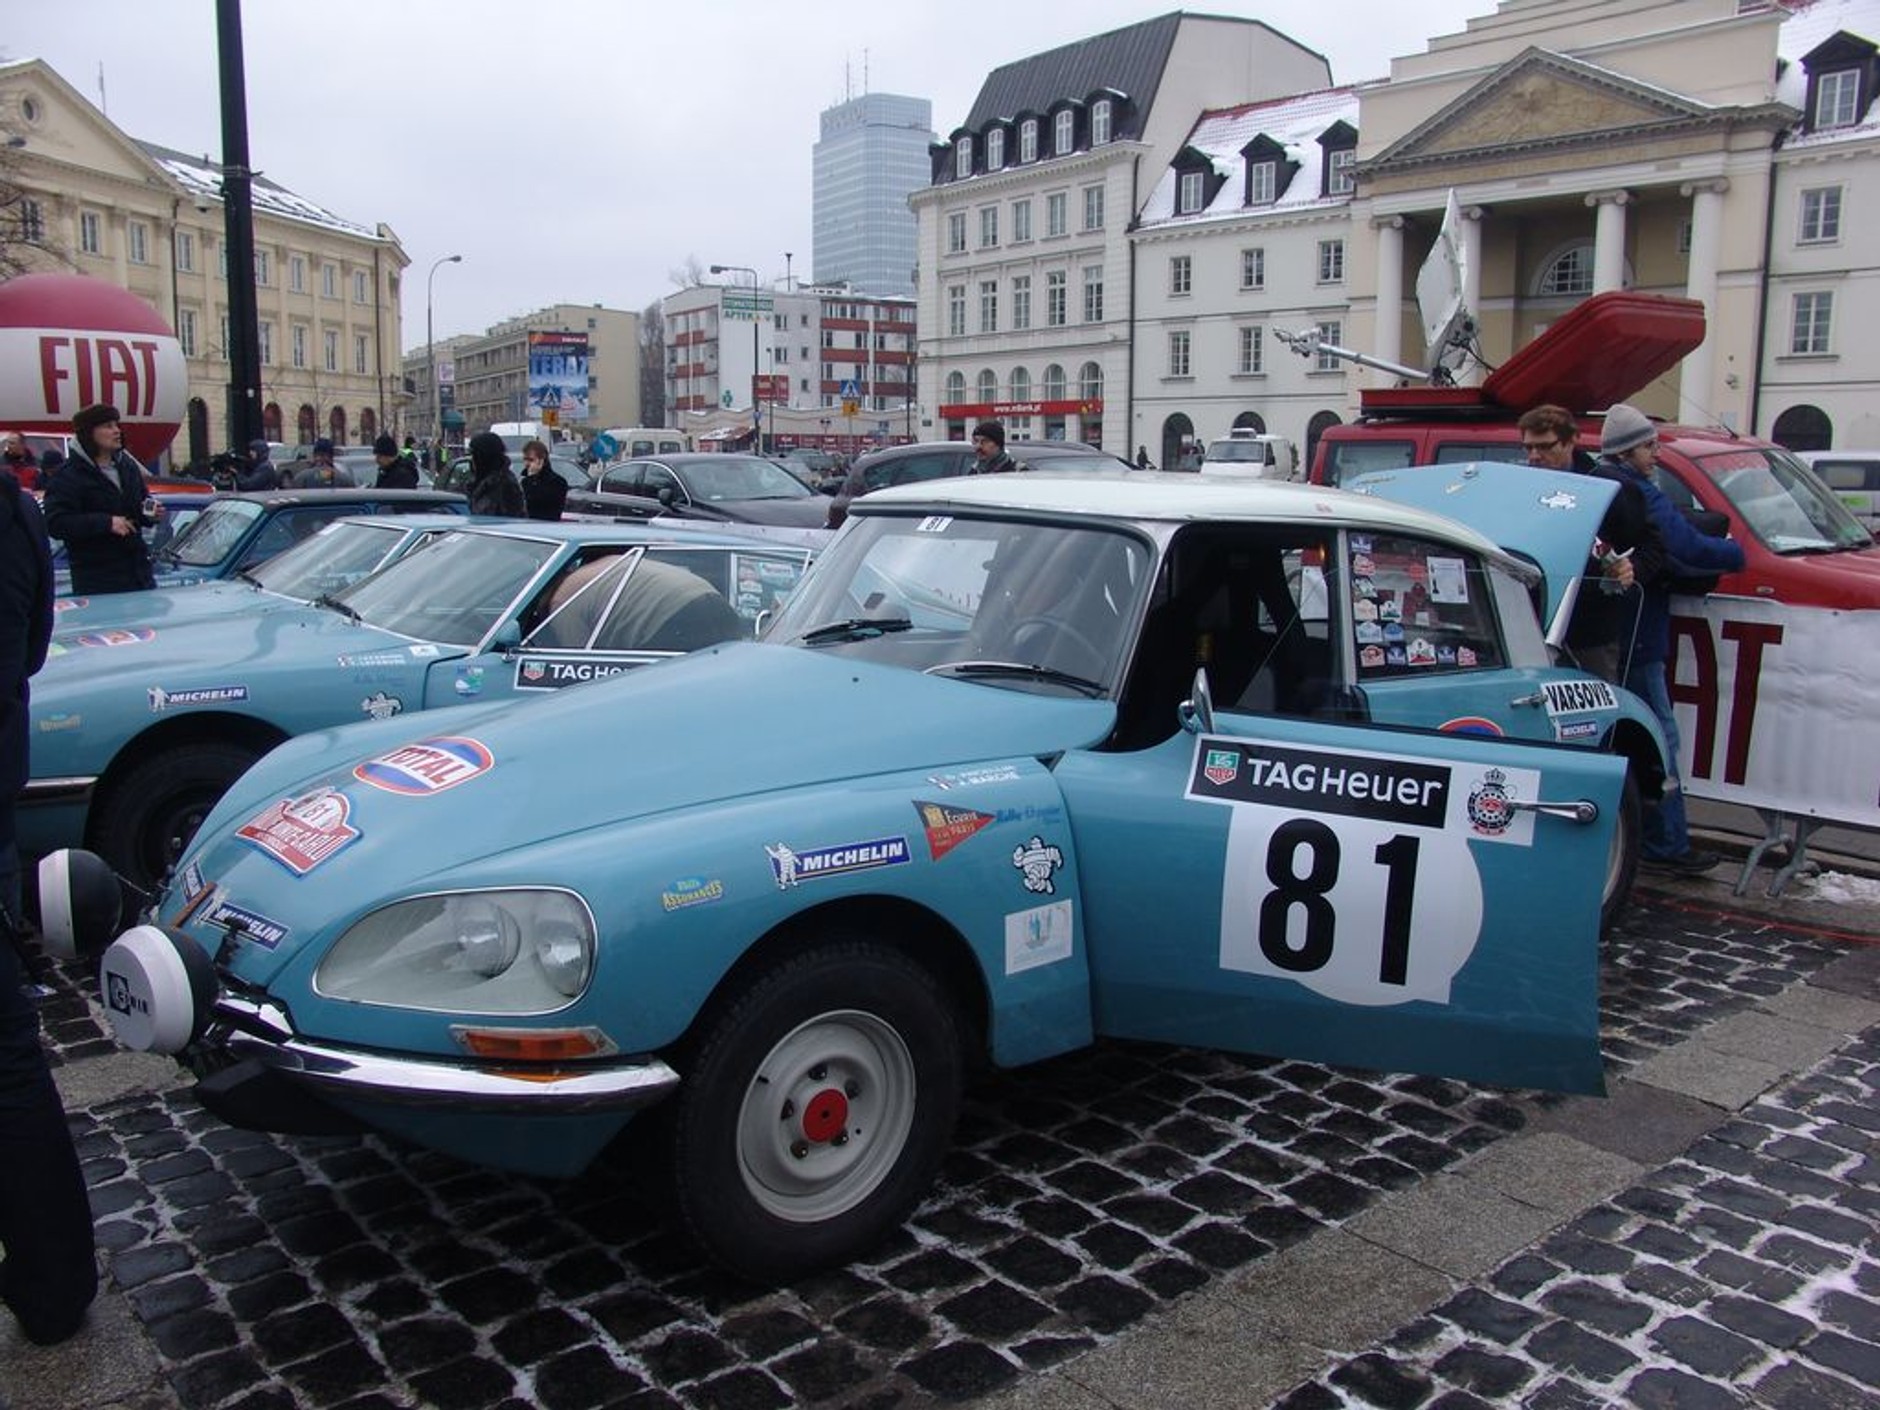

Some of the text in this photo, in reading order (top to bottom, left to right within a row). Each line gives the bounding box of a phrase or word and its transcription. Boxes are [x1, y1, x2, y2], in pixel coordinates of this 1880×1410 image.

[39, 336, 159, 416] FIAT
[169, 688, 245, 703] MICHELIN
[1546, 683, 1613, 711] VARSOVIE
[1665, 615, 1784, 786] AT
[382, 747, 466, 785] TOTAL
[802, 842, 903, 872] MICHELIN
[1259, 818, 1420, 986] 81
